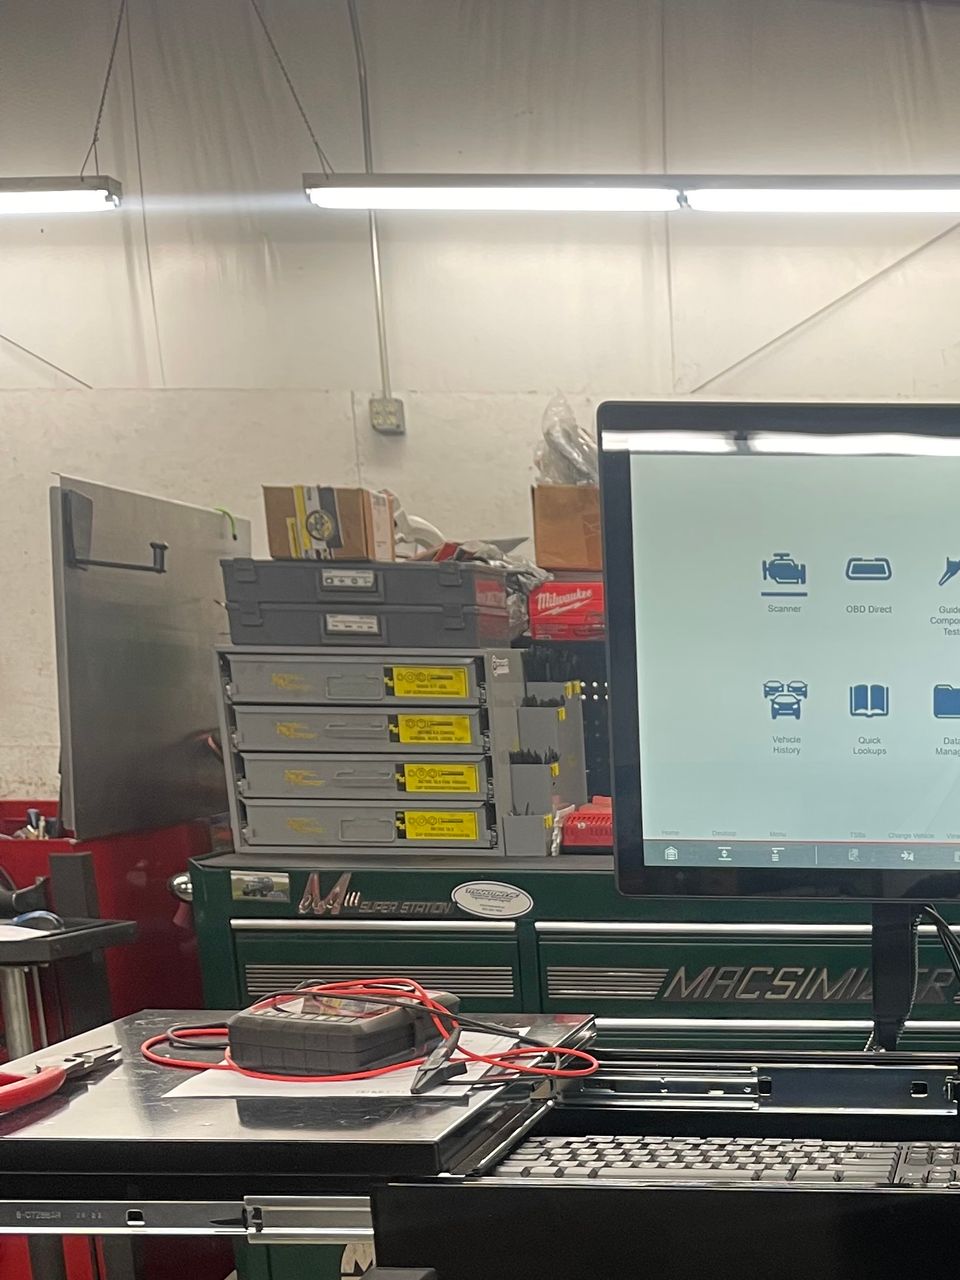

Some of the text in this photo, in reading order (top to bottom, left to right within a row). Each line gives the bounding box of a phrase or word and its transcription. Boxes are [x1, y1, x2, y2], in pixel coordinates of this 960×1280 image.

[536, 588, 593, 610] Milwaukee
[767, 604, 802, 613] Scanner
[846, 605, 892, 614] OBD Direct
[772, 735, 802, 744] Vehicle
[858, 736, 881, 745] Quick
[772, 746, 801, 756] History
[852, 747, 887, 756] Lookups
[888, 832, 912, 840] Change
[358, 901, 454, 914] SUPER STATION
[663, 966, 955, 1000] MACSIMIR
